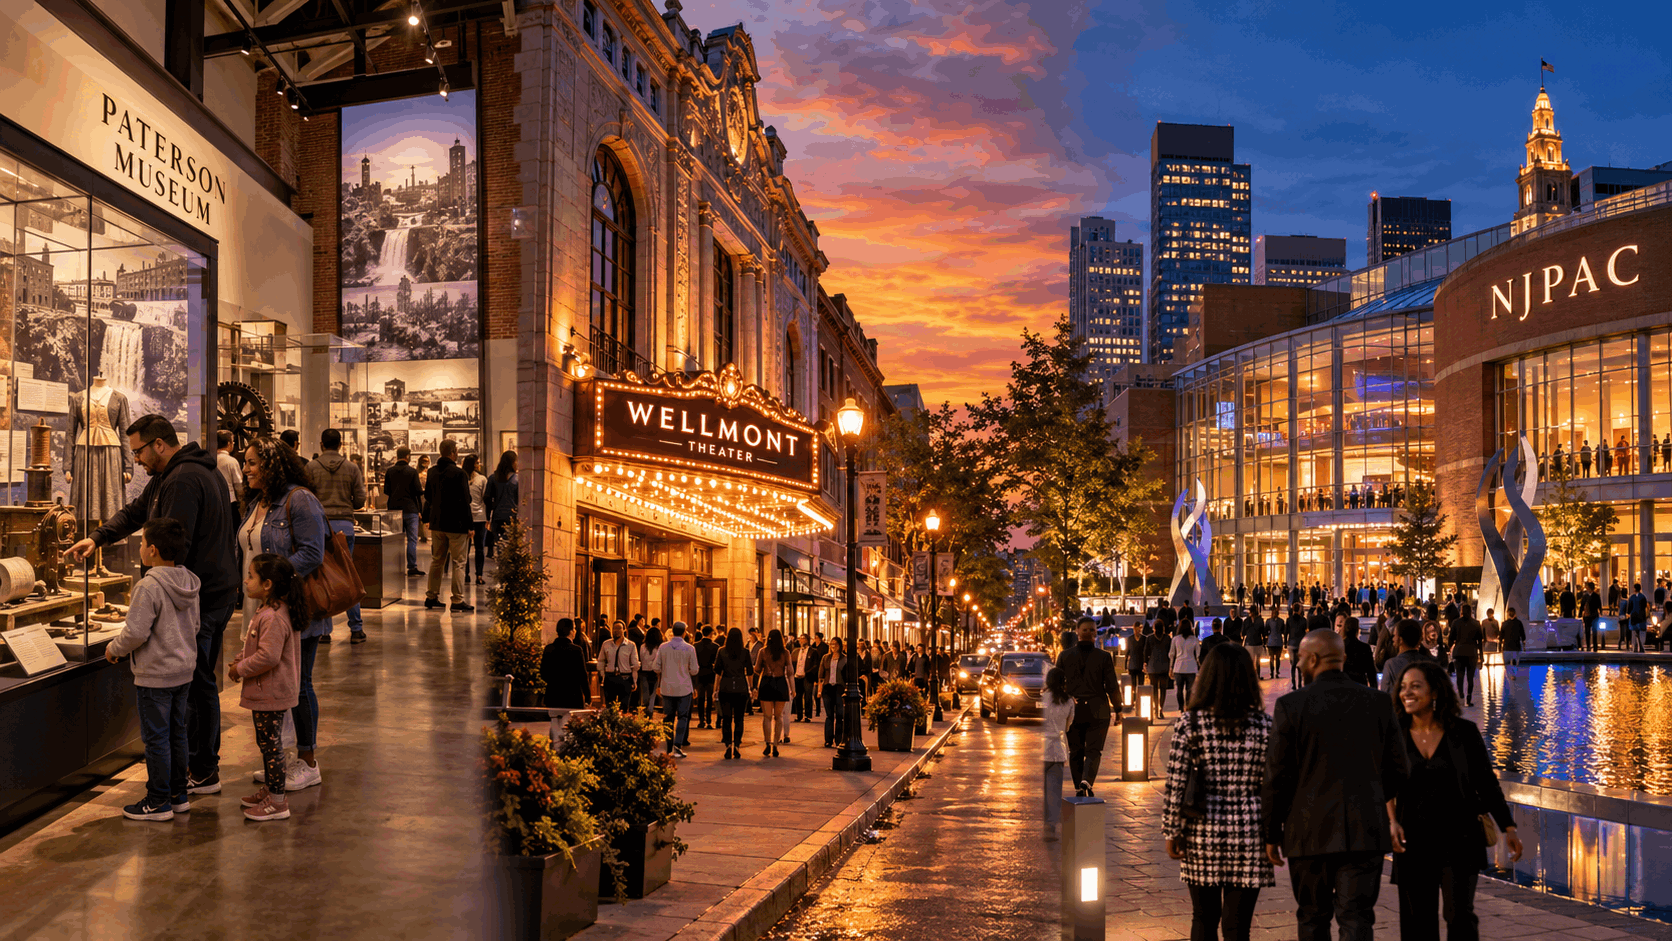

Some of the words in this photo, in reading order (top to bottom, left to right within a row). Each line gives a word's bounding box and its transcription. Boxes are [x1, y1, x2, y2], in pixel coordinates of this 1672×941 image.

[102, 93, 226, 204] PATERSON
[115, 142, 211, 225] MUSEUM
[1491, 245, 1640, 321] NJPAC
[628, 401, 798, 456] WELLMONT
[688, 441, 753, 462] THEATER
